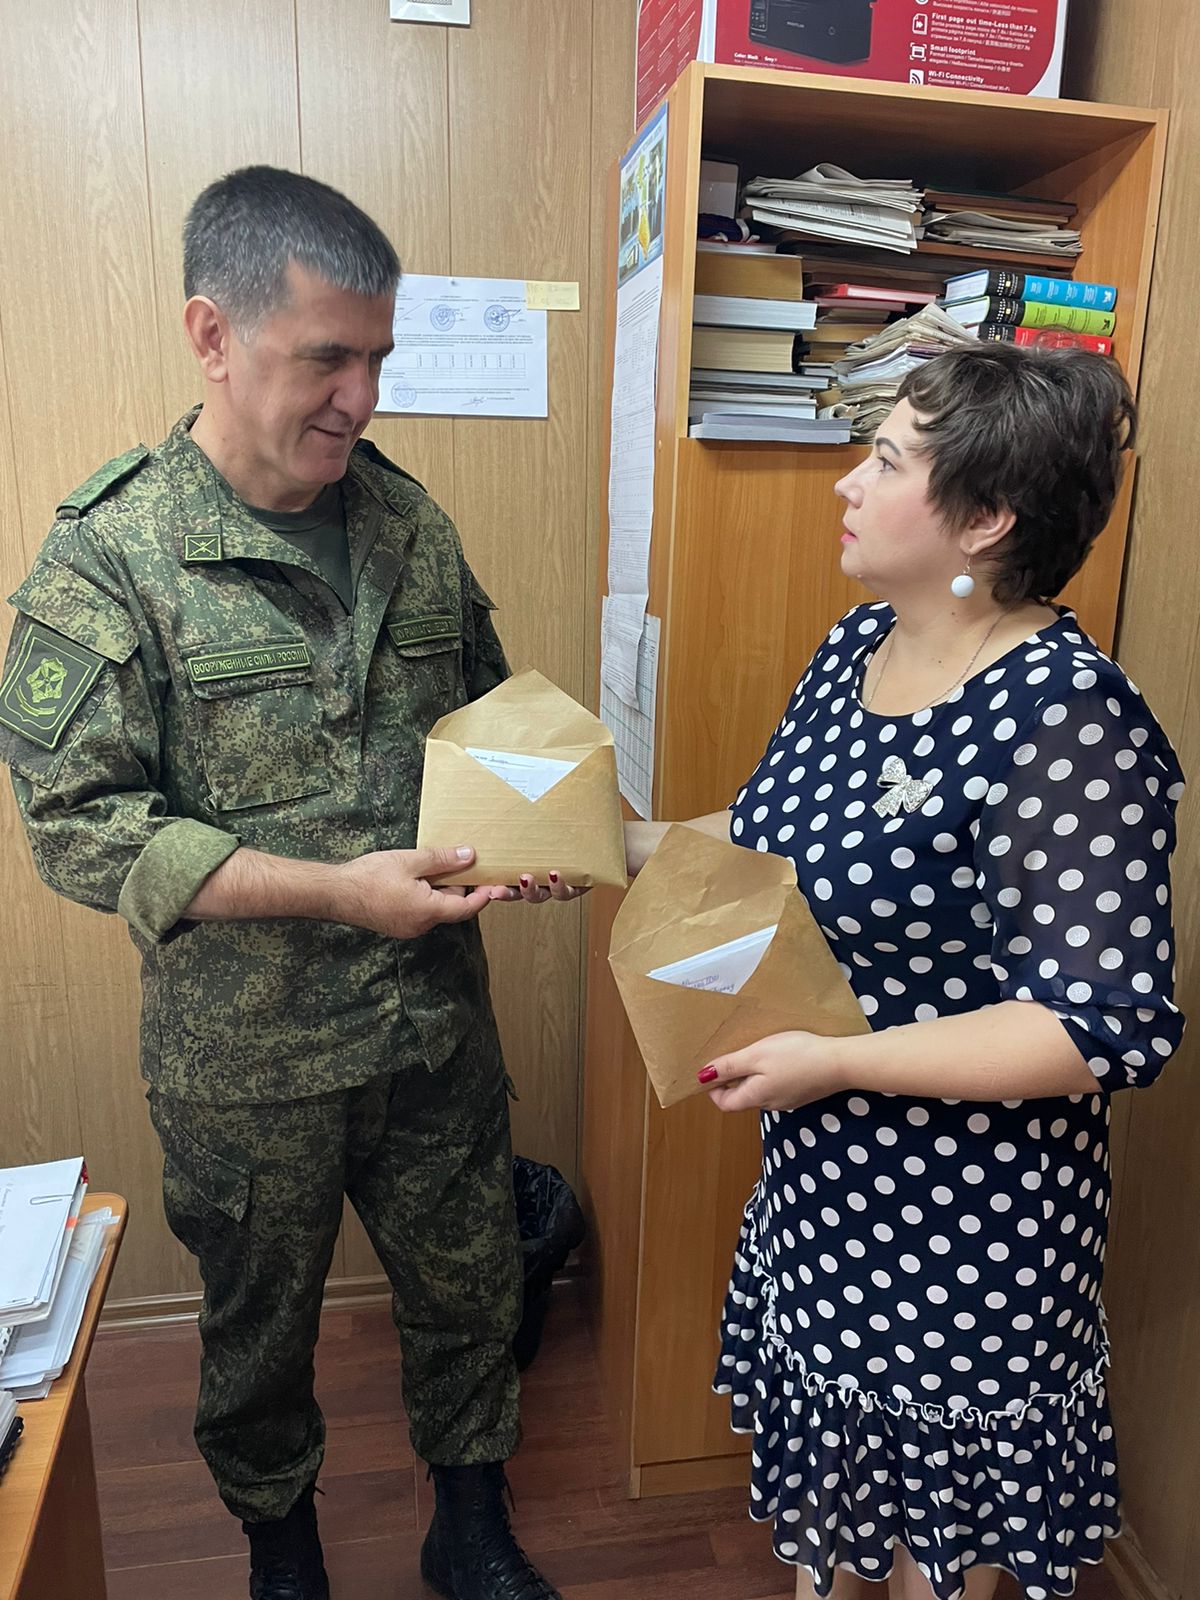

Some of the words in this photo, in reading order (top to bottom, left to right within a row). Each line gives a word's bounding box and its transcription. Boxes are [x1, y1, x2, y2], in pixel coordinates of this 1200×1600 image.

[932, 13, 946, 21] First
[949, 16, 963, 25] page
[930, 44, 948, 52] Small
[949, 46, 975, 56] footprint
[928, 70, 944, 78] Wi-Fi
[945, 73, 984, 84] Connectivity
[193, 656, 253, 675] ВООРУЖЕННЫЕ
[254, 651, 277, 667] СИЛЫ
[278, 649, 306, 662] РОССИИ
